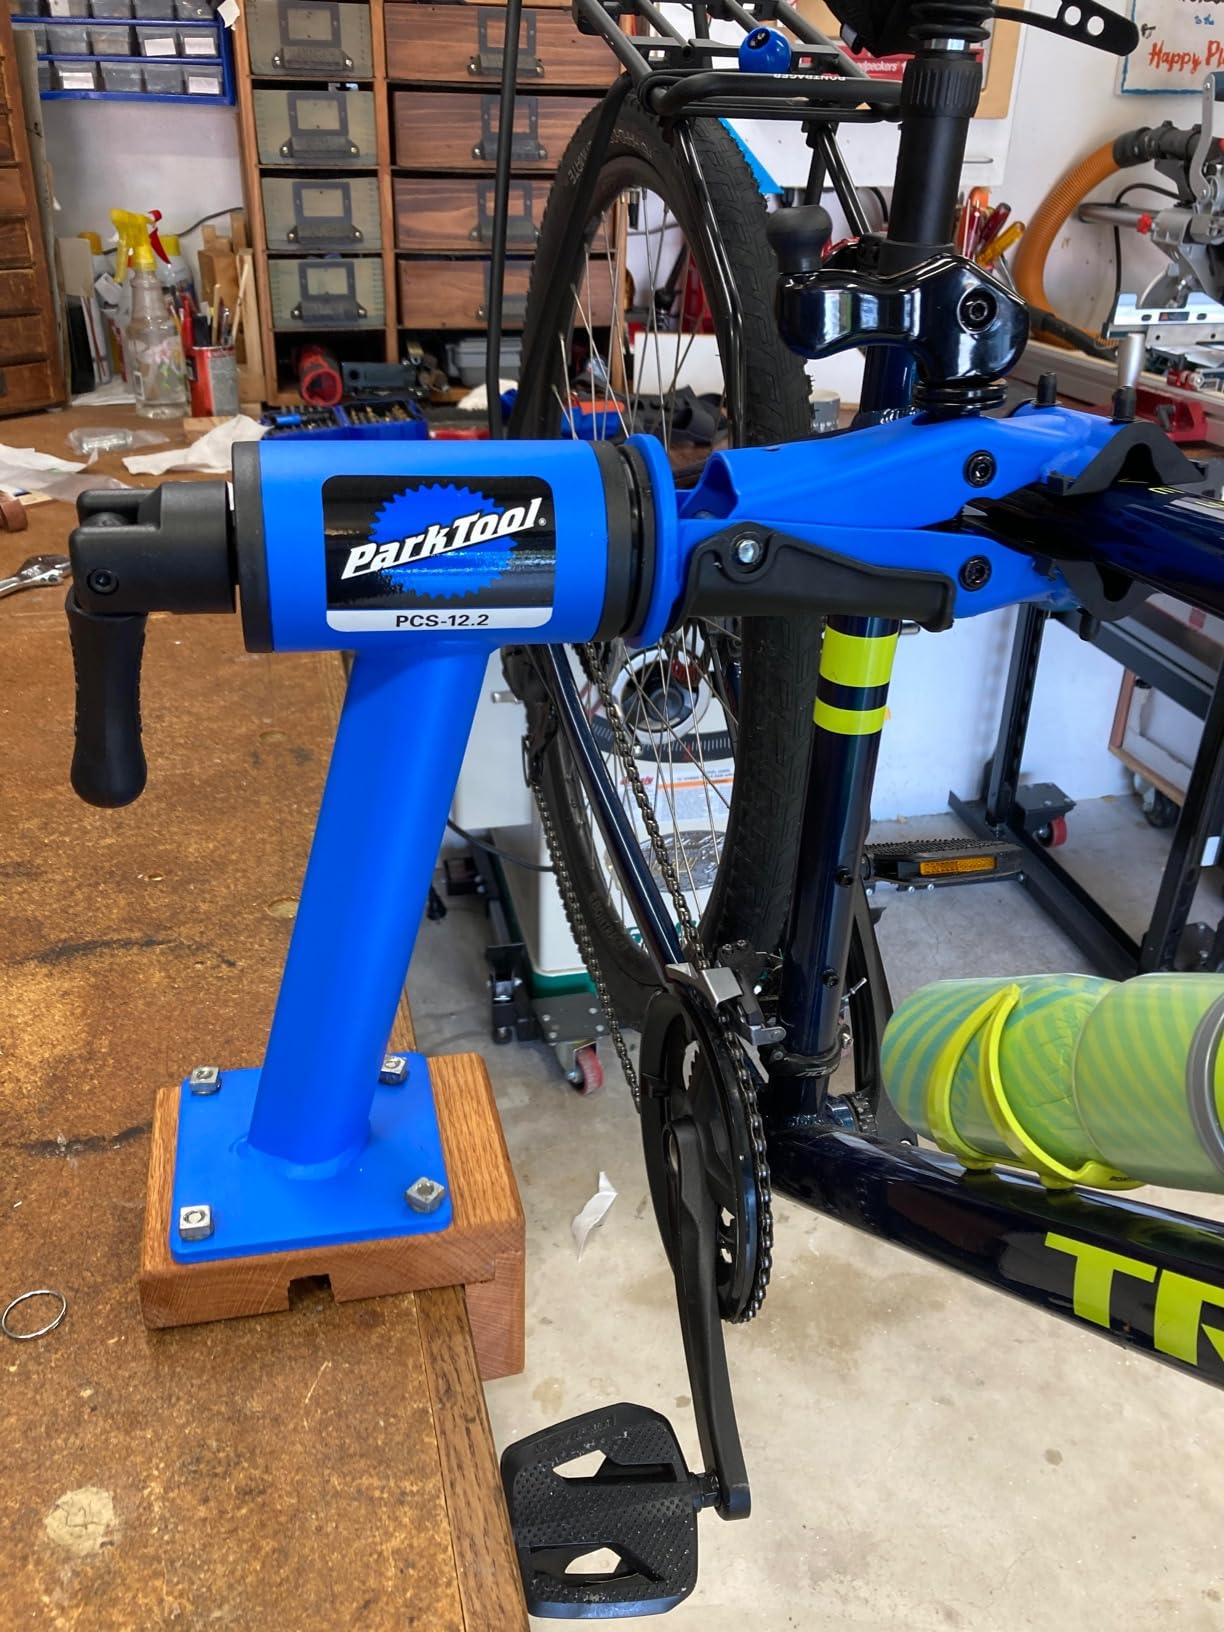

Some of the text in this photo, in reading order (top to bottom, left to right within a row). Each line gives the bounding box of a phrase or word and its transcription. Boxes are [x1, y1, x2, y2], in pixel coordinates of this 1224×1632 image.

[1148, 41, 1224, 75] Happy Pl
[395, 613, 490, 628] PCS-12.2
